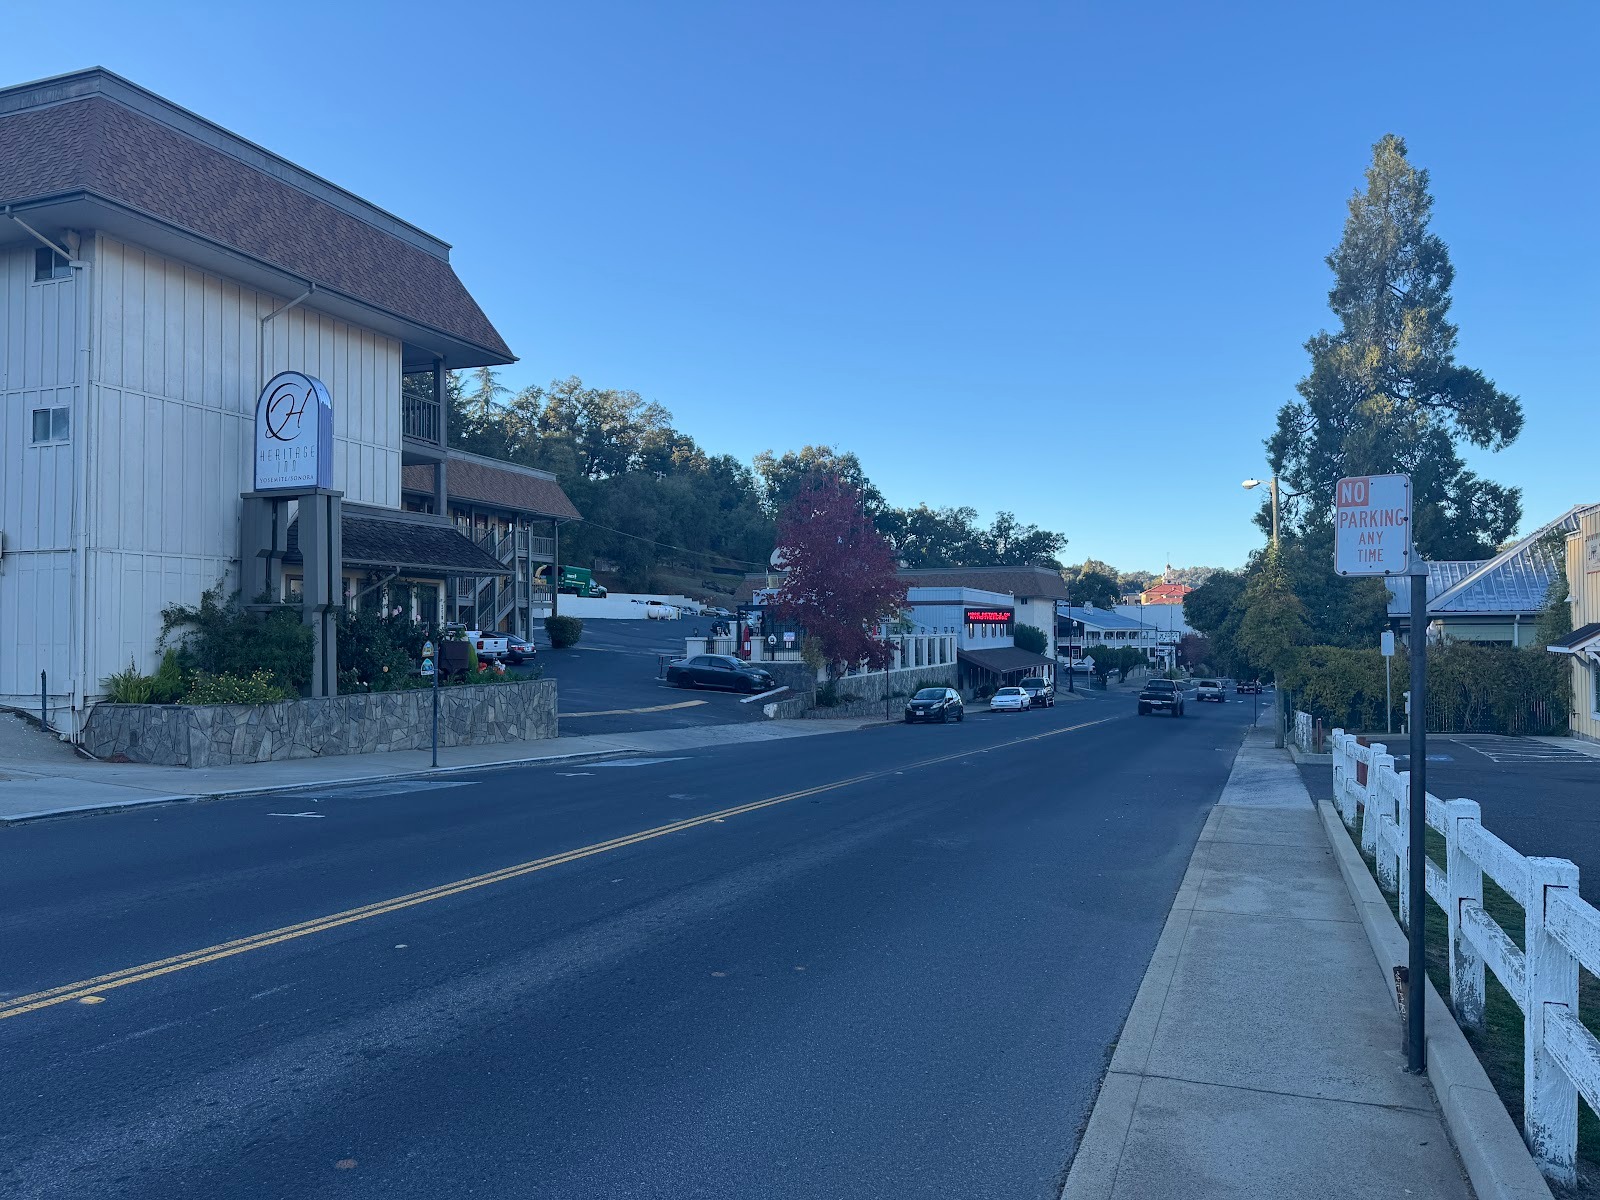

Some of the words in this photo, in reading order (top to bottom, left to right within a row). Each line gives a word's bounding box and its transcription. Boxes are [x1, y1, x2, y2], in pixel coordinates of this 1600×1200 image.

[260, 445, 316, 462] HERITAGE
[259, 474, 314, 484] YOSEMITE/SONORA
[1341, 481, 1365, 503] NO
[1340, 508, 1405, 528] PARKING
[1358, 531, 1384, 545] ANY
[1358, 549, 1384, 562] TIME
